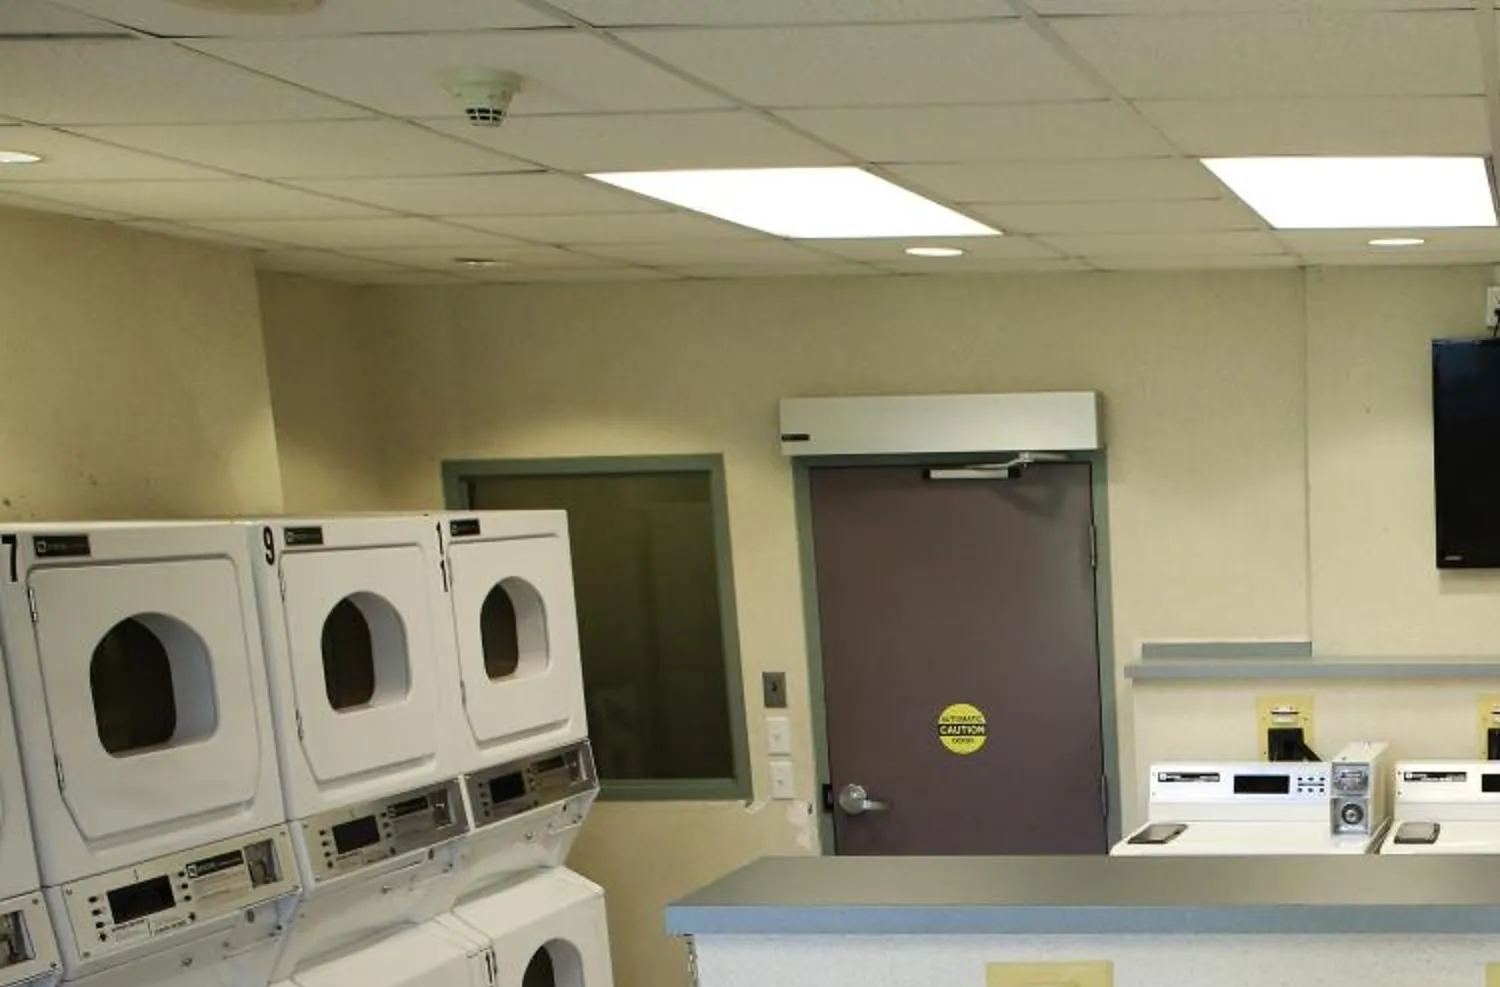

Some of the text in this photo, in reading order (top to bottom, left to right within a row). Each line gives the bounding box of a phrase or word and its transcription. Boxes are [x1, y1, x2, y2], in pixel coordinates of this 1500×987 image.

[1, 533, 19, 583] 7
[263, 525, 276, 567] 9
[940, 725, 985, 735] CAUTION
